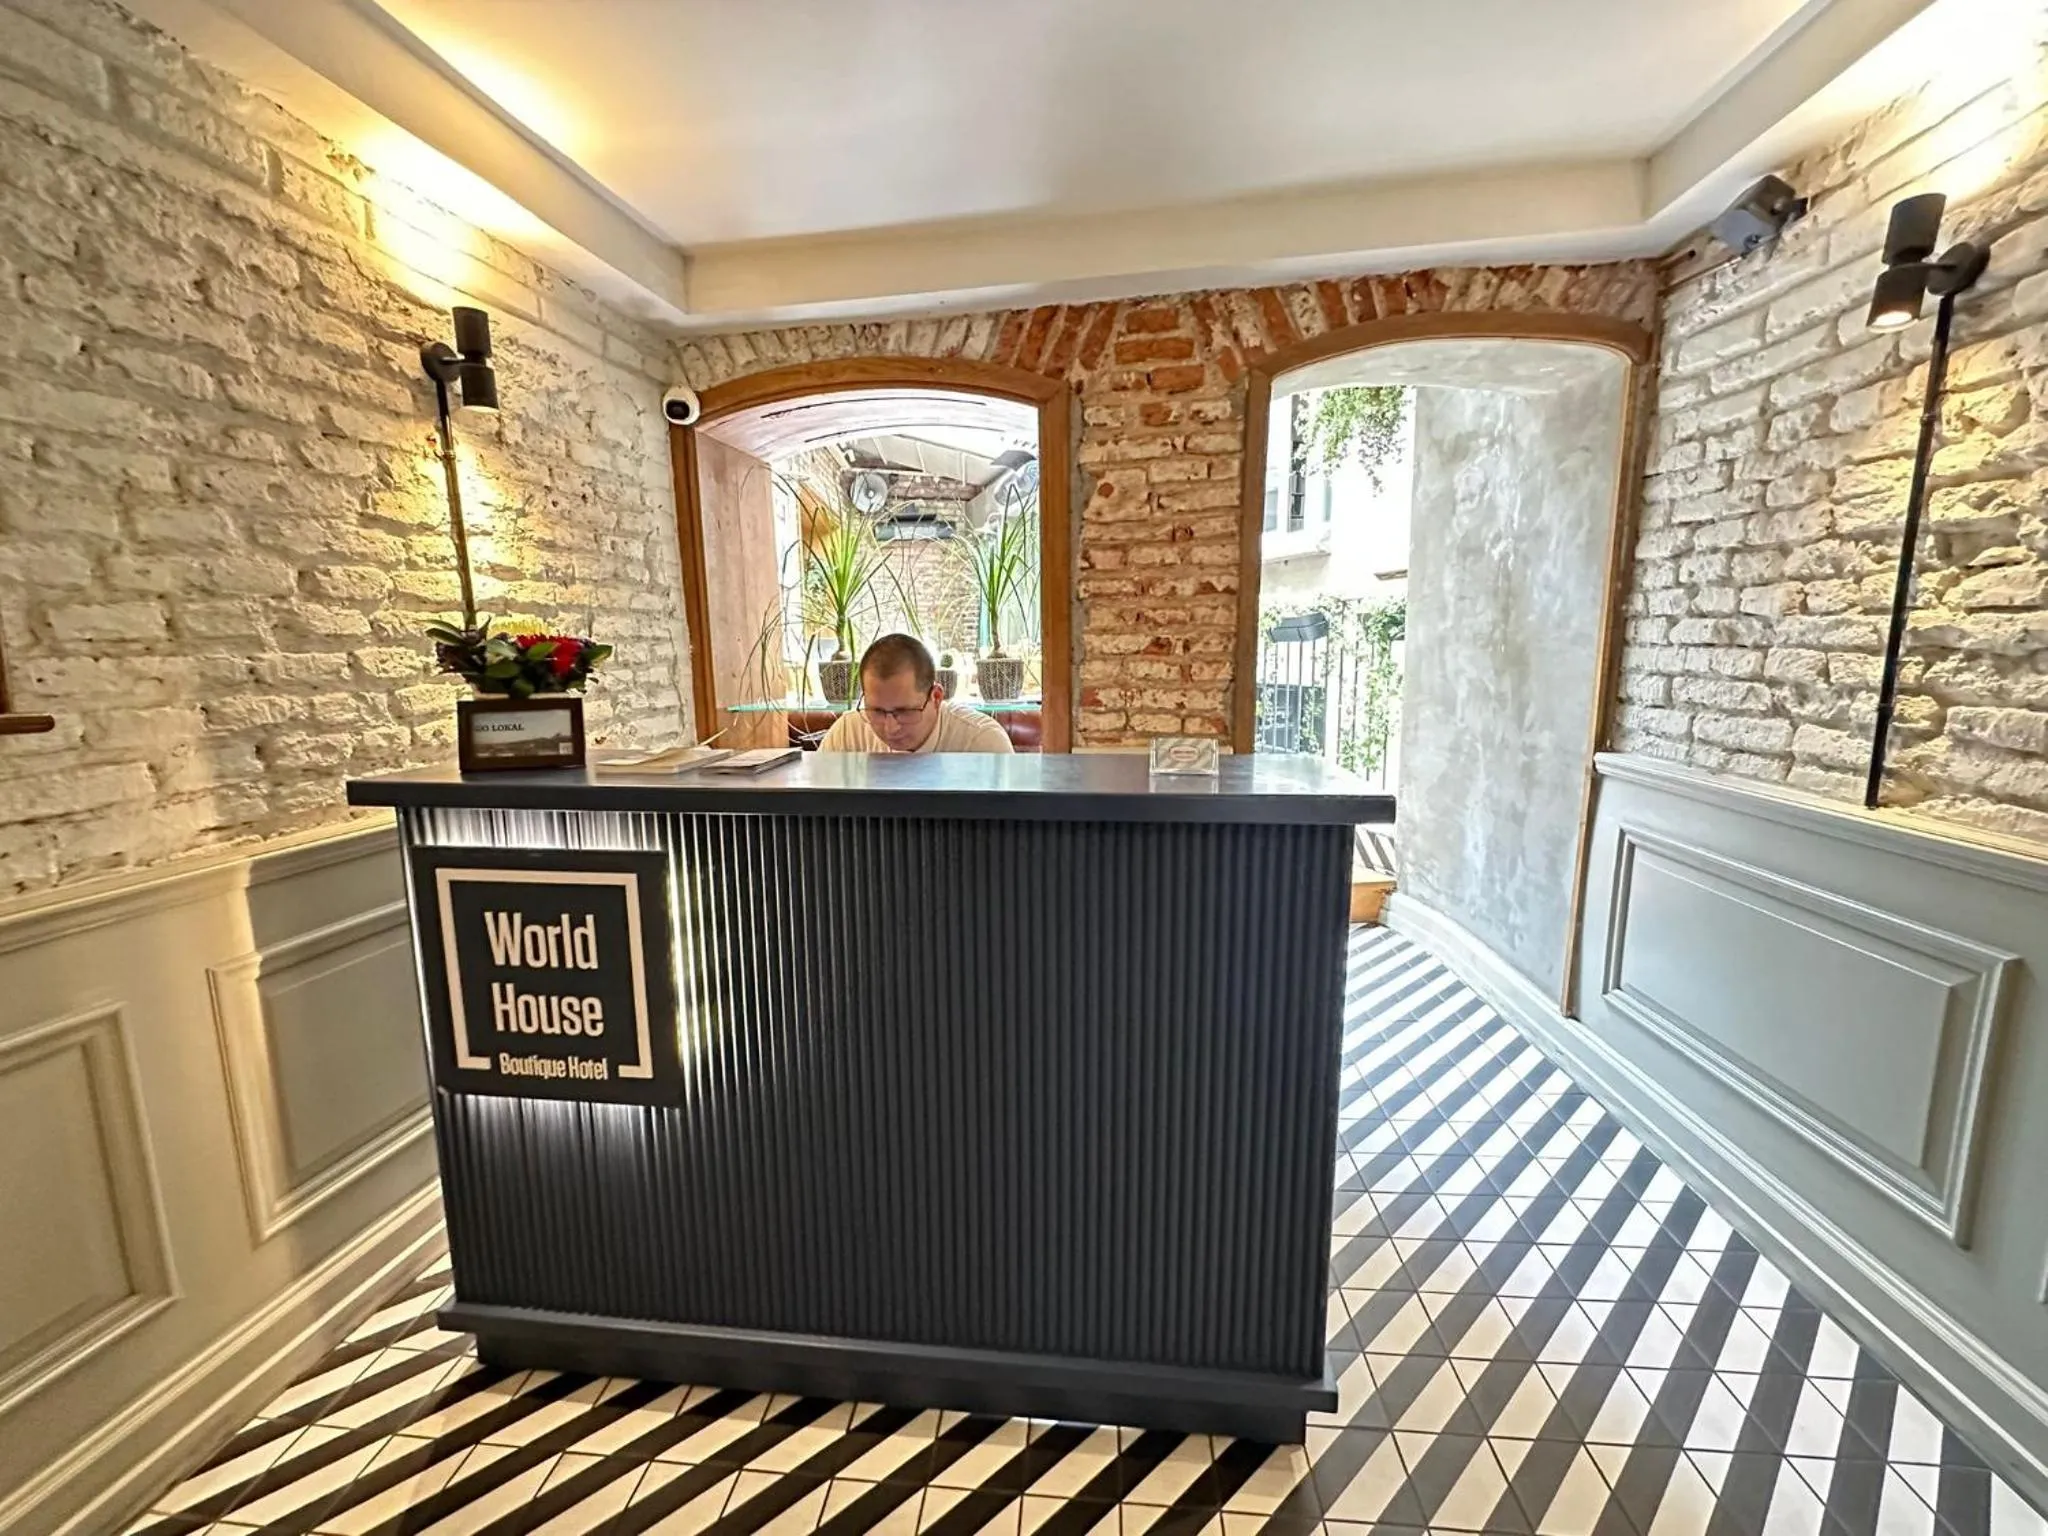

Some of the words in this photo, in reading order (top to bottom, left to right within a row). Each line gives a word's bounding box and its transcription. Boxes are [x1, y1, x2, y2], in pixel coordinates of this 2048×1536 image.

[492, 723, 525, 732] LOKAL
[484, 911, 599, 970] World
[490, 982, 604, 1037] House
[499, 1052, 567, 1079] Boutique
[567, 1055, 609, 1080] Hotel
